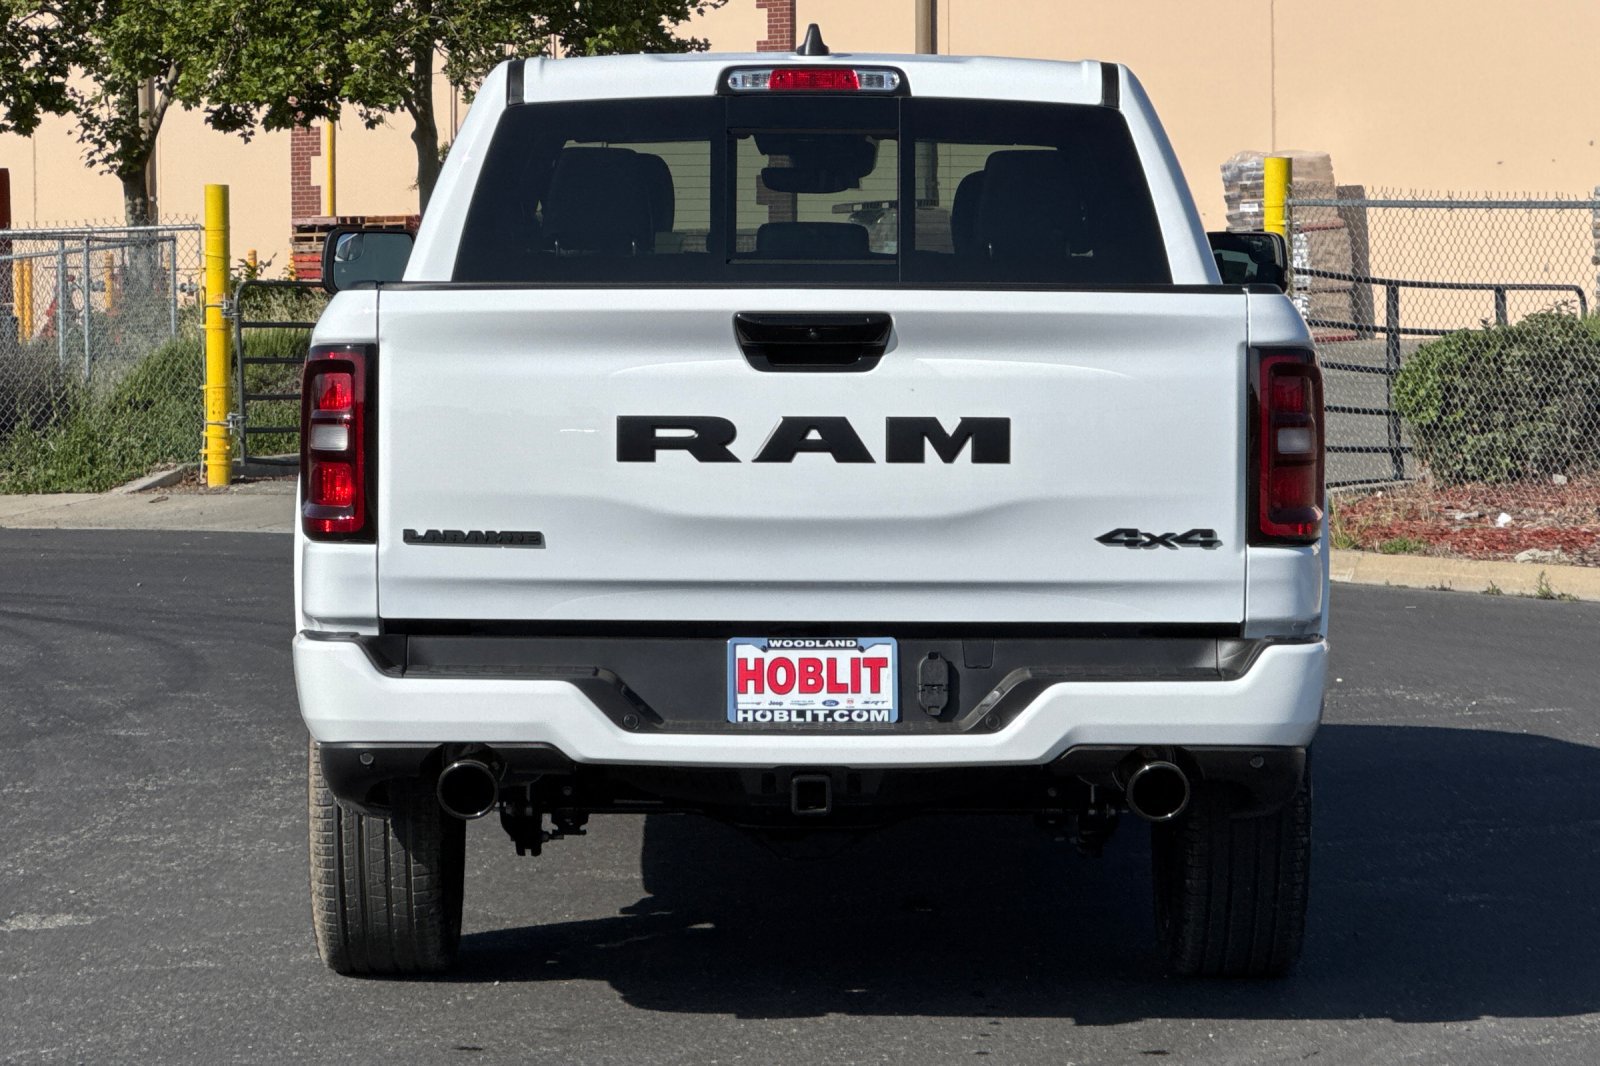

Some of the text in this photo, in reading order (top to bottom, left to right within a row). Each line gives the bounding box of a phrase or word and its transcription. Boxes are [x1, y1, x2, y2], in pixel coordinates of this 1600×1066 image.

[616, 415, 1011, 464] RAM
[402, 528, 543, 546] LARAMIE
[1094, 527, 1222, 549] 4x4
[769, 639, 857, 648] WOODLAND
[737, 656, 889, 696] HOBLIT
[737, 710, 889, 722] HOBLIT.COM
